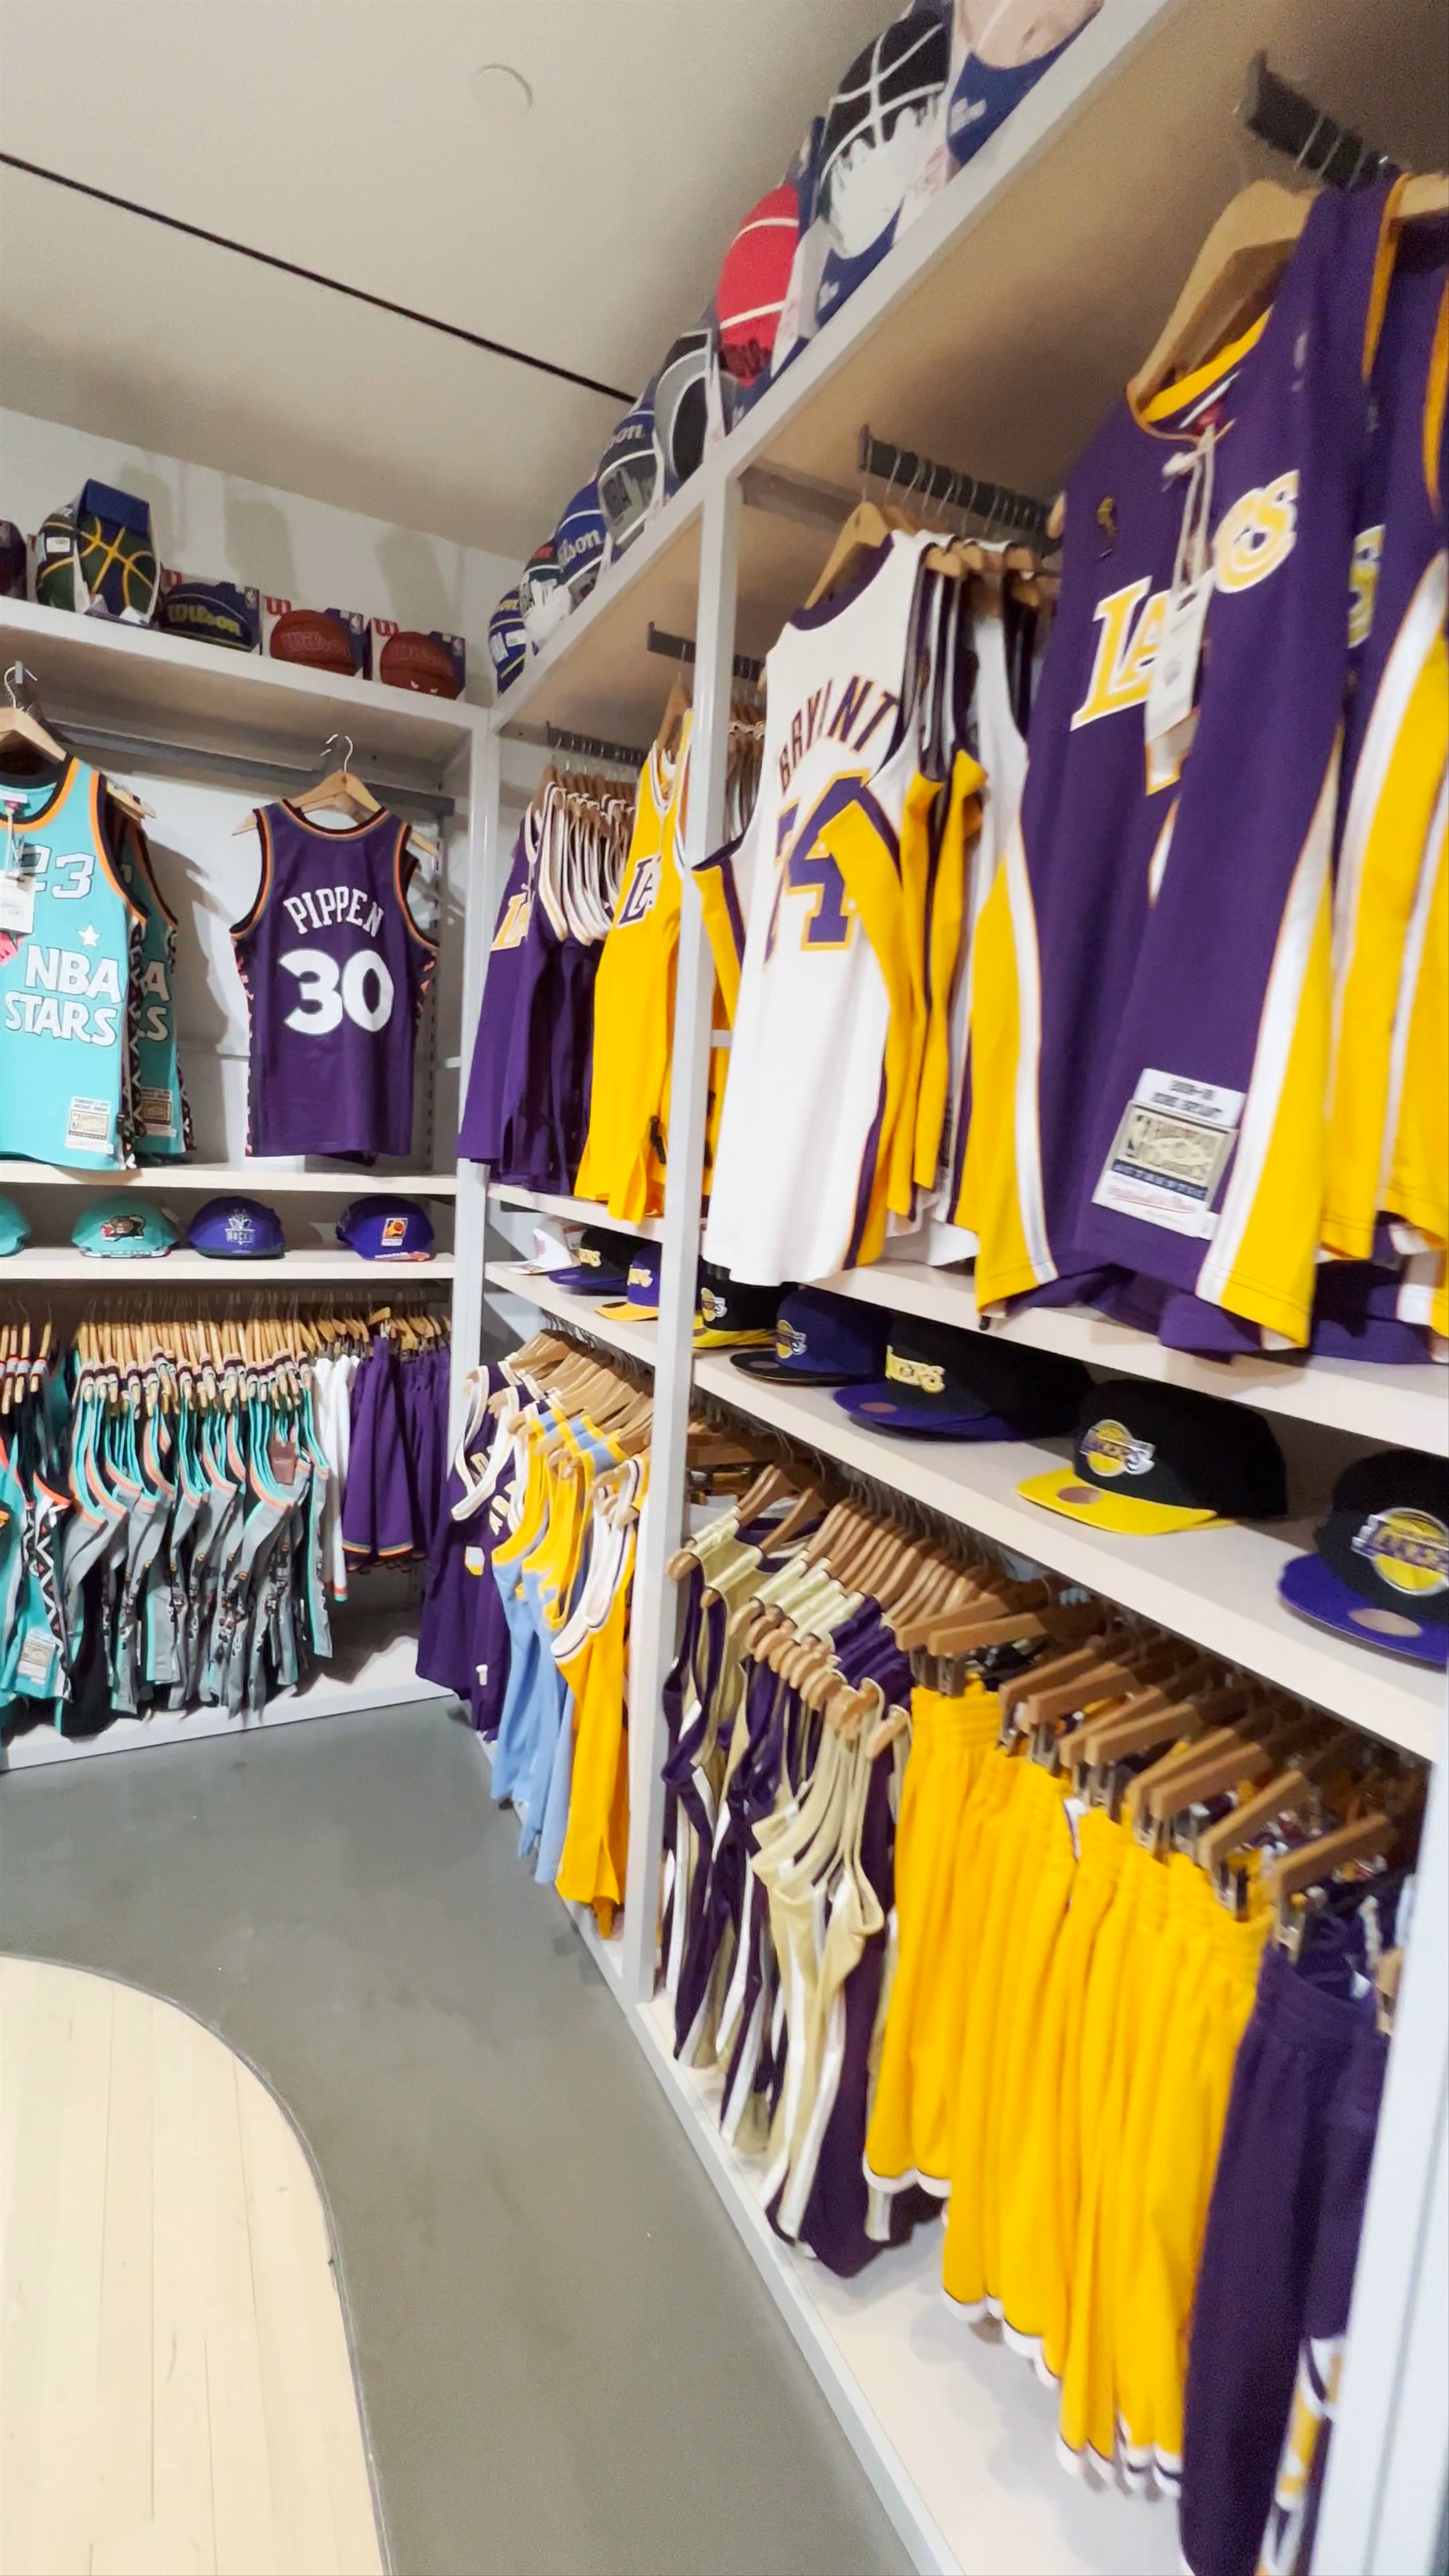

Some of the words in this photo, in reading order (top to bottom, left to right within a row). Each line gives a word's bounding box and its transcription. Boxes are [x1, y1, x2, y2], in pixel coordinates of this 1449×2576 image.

[283, 886, 383, 937] PIPPEN
[25, 944, 123, 1004] NBA
[278, 948, 395, 1035] 30
[5, 990, 117, 1047] STARS
